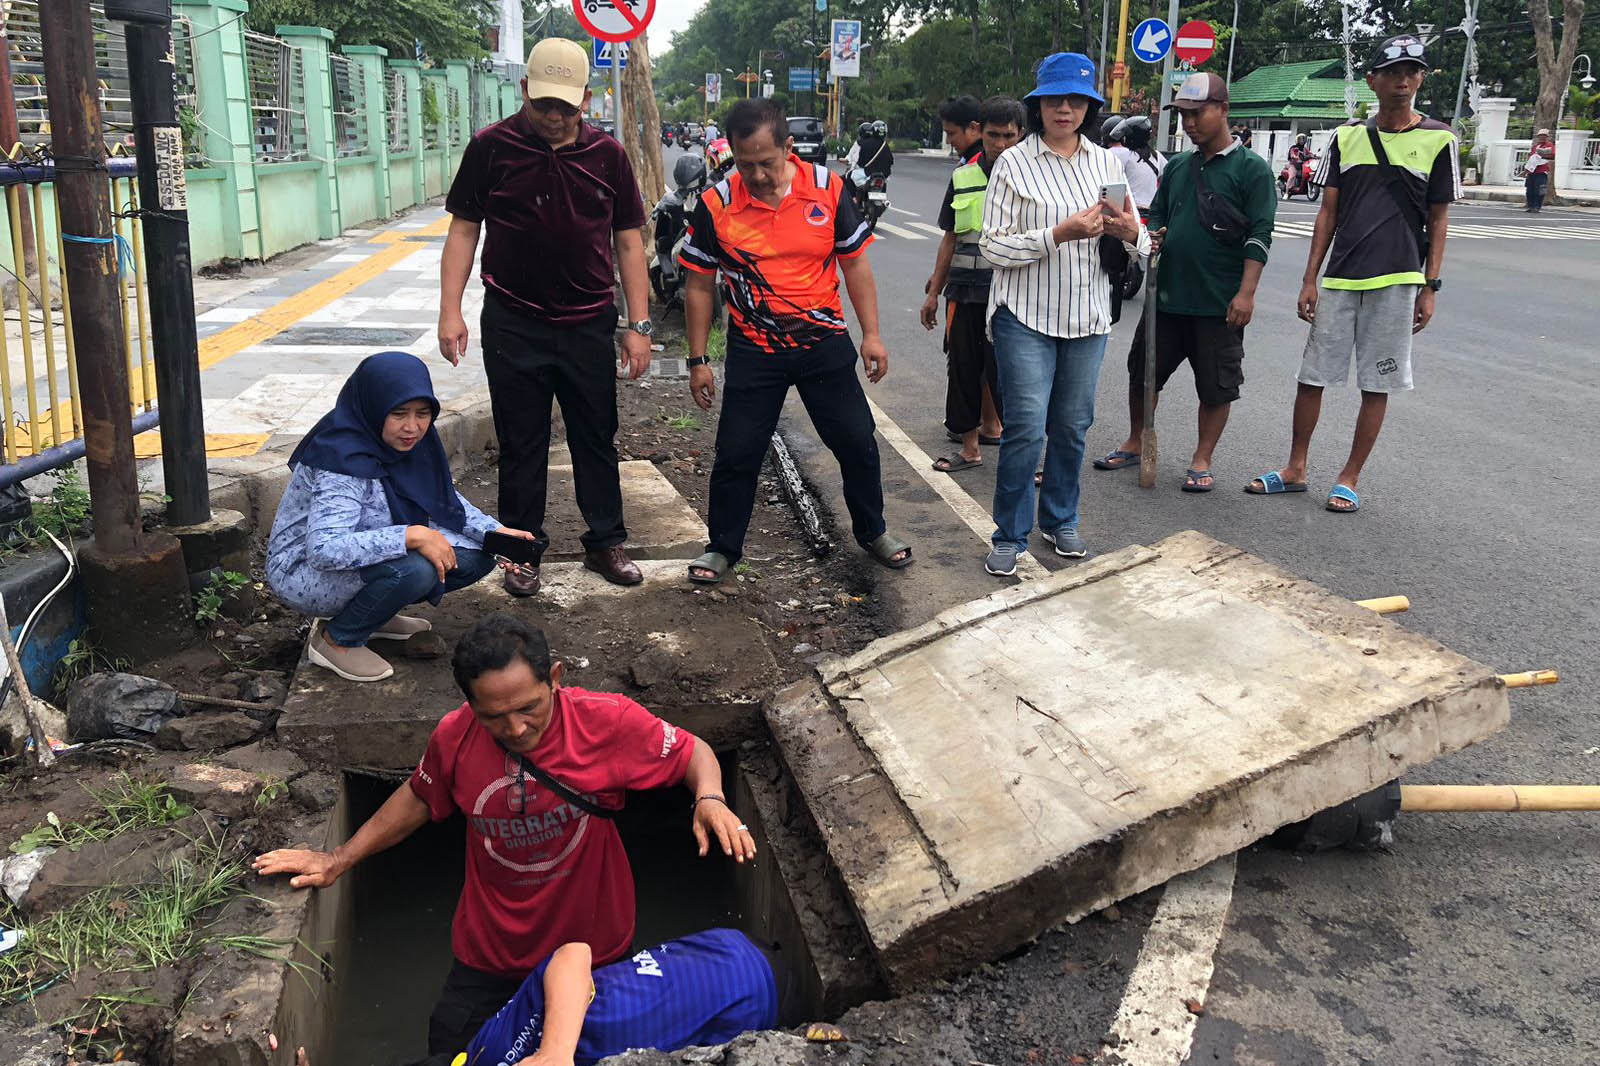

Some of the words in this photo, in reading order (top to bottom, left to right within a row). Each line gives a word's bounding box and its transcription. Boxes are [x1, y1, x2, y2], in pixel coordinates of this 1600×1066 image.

[156, 132, 168, 151] WC
[158, 155, 172, 194] SEDOT
[504, 826, 564, 850] DIVISION
